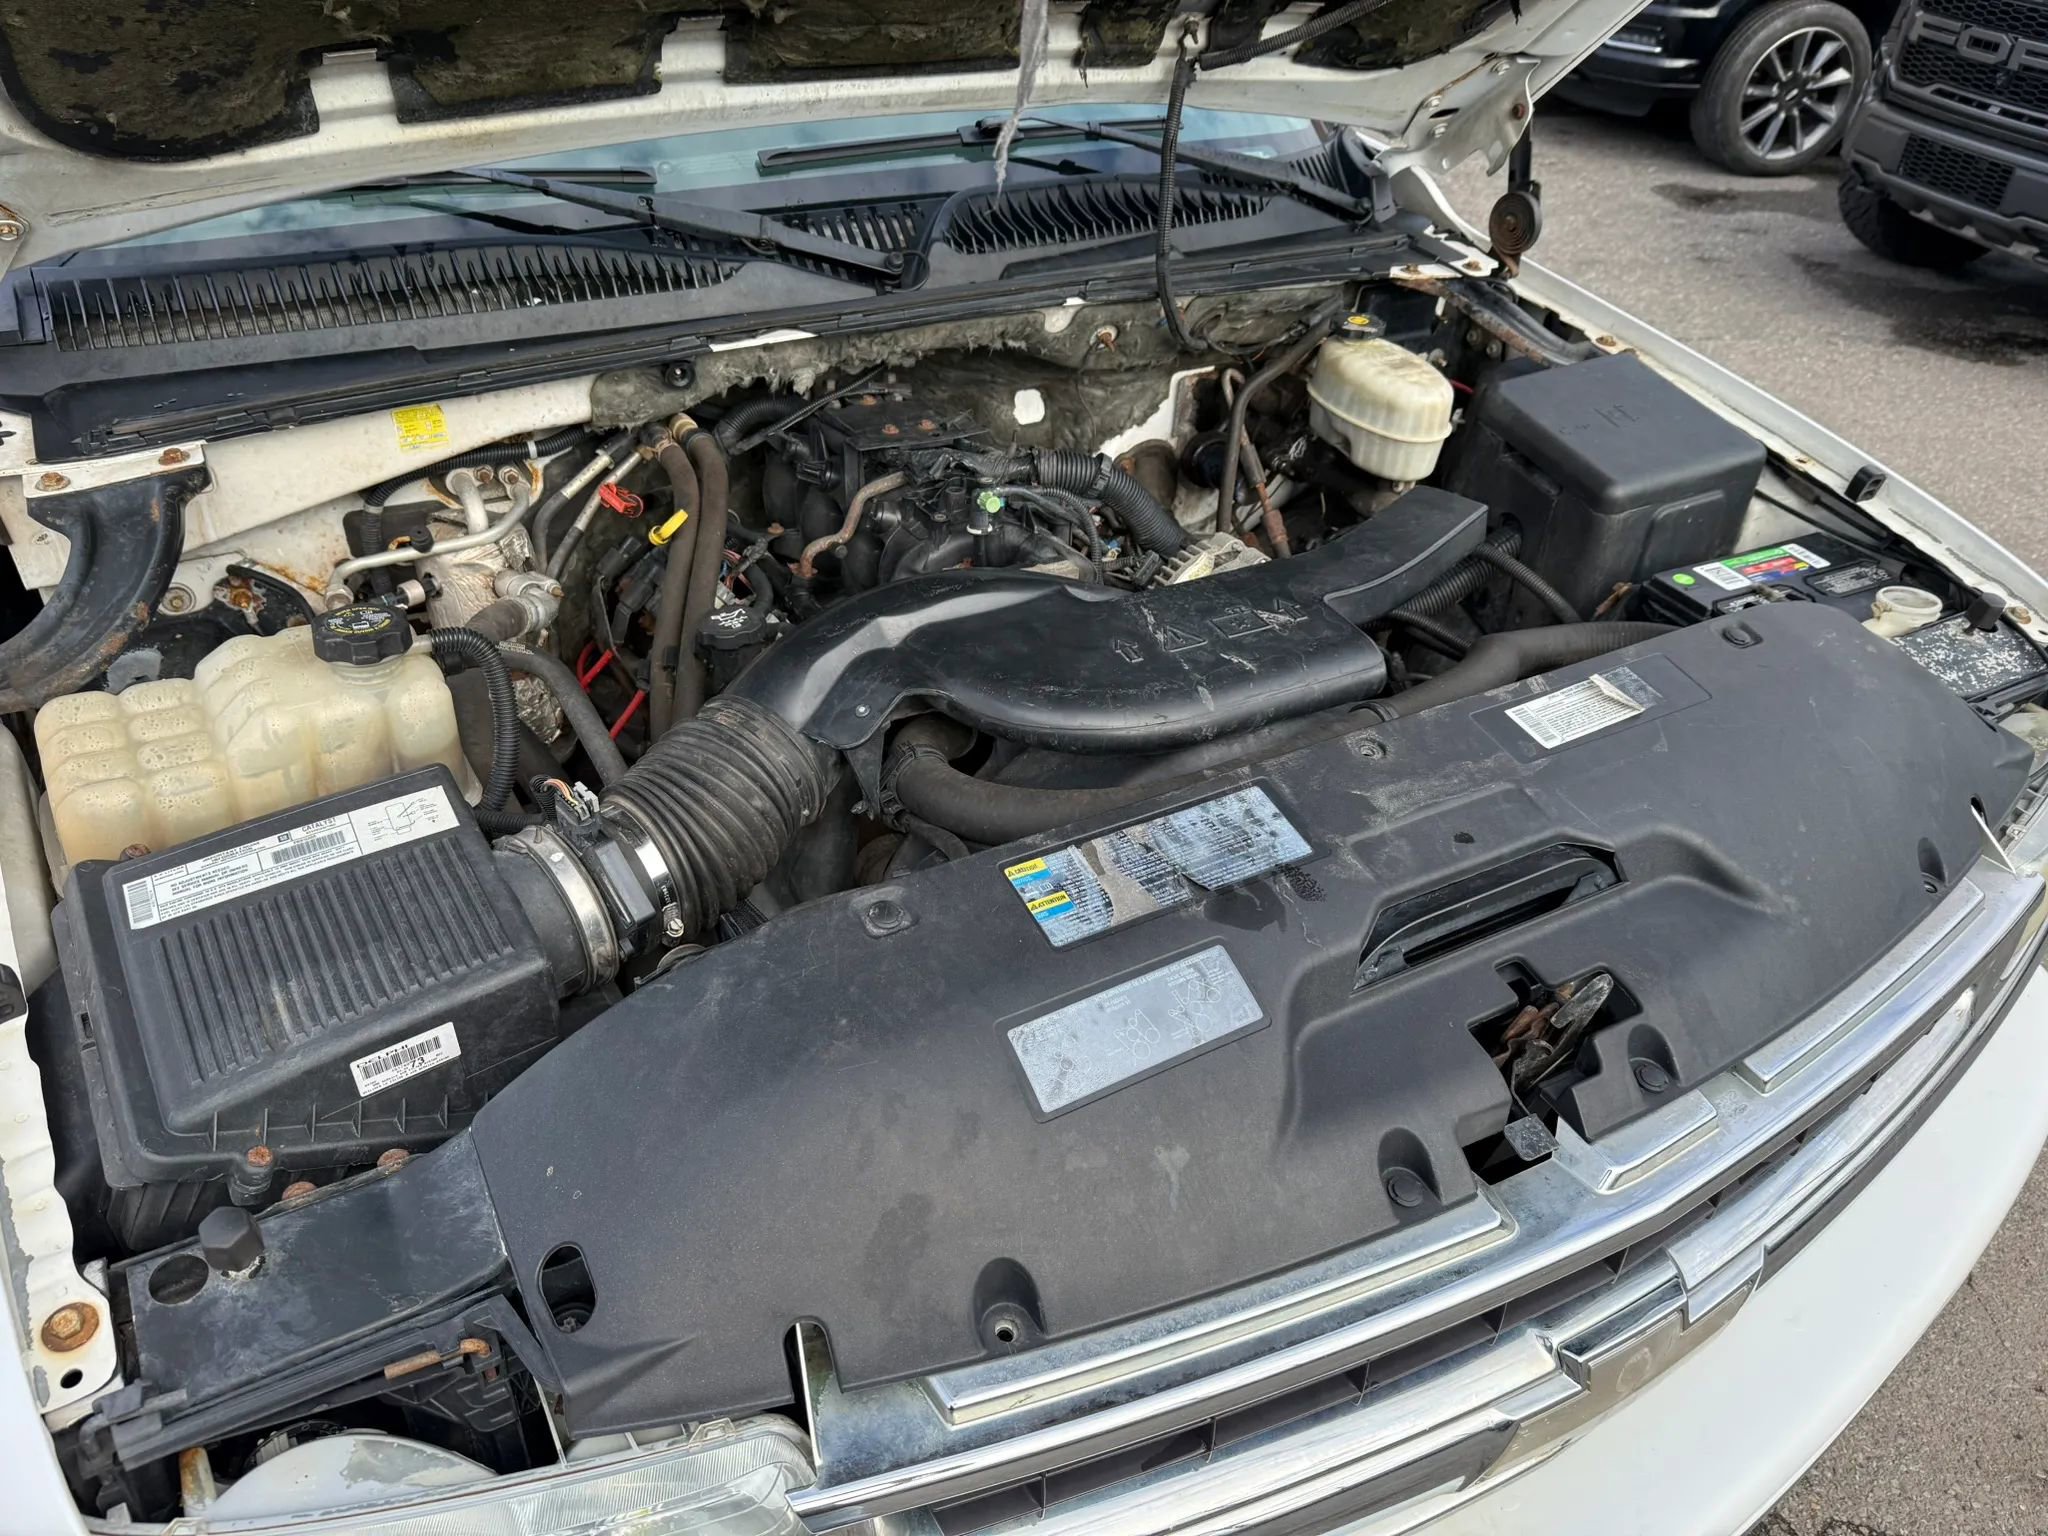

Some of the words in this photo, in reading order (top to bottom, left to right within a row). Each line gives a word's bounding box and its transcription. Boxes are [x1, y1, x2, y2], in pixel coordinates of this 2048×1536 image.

[301, 818, 336, 832] CATALYST
[1038, 894, 1066, 908] ATTENTION
[411, 1056, 425, 1068] 73
